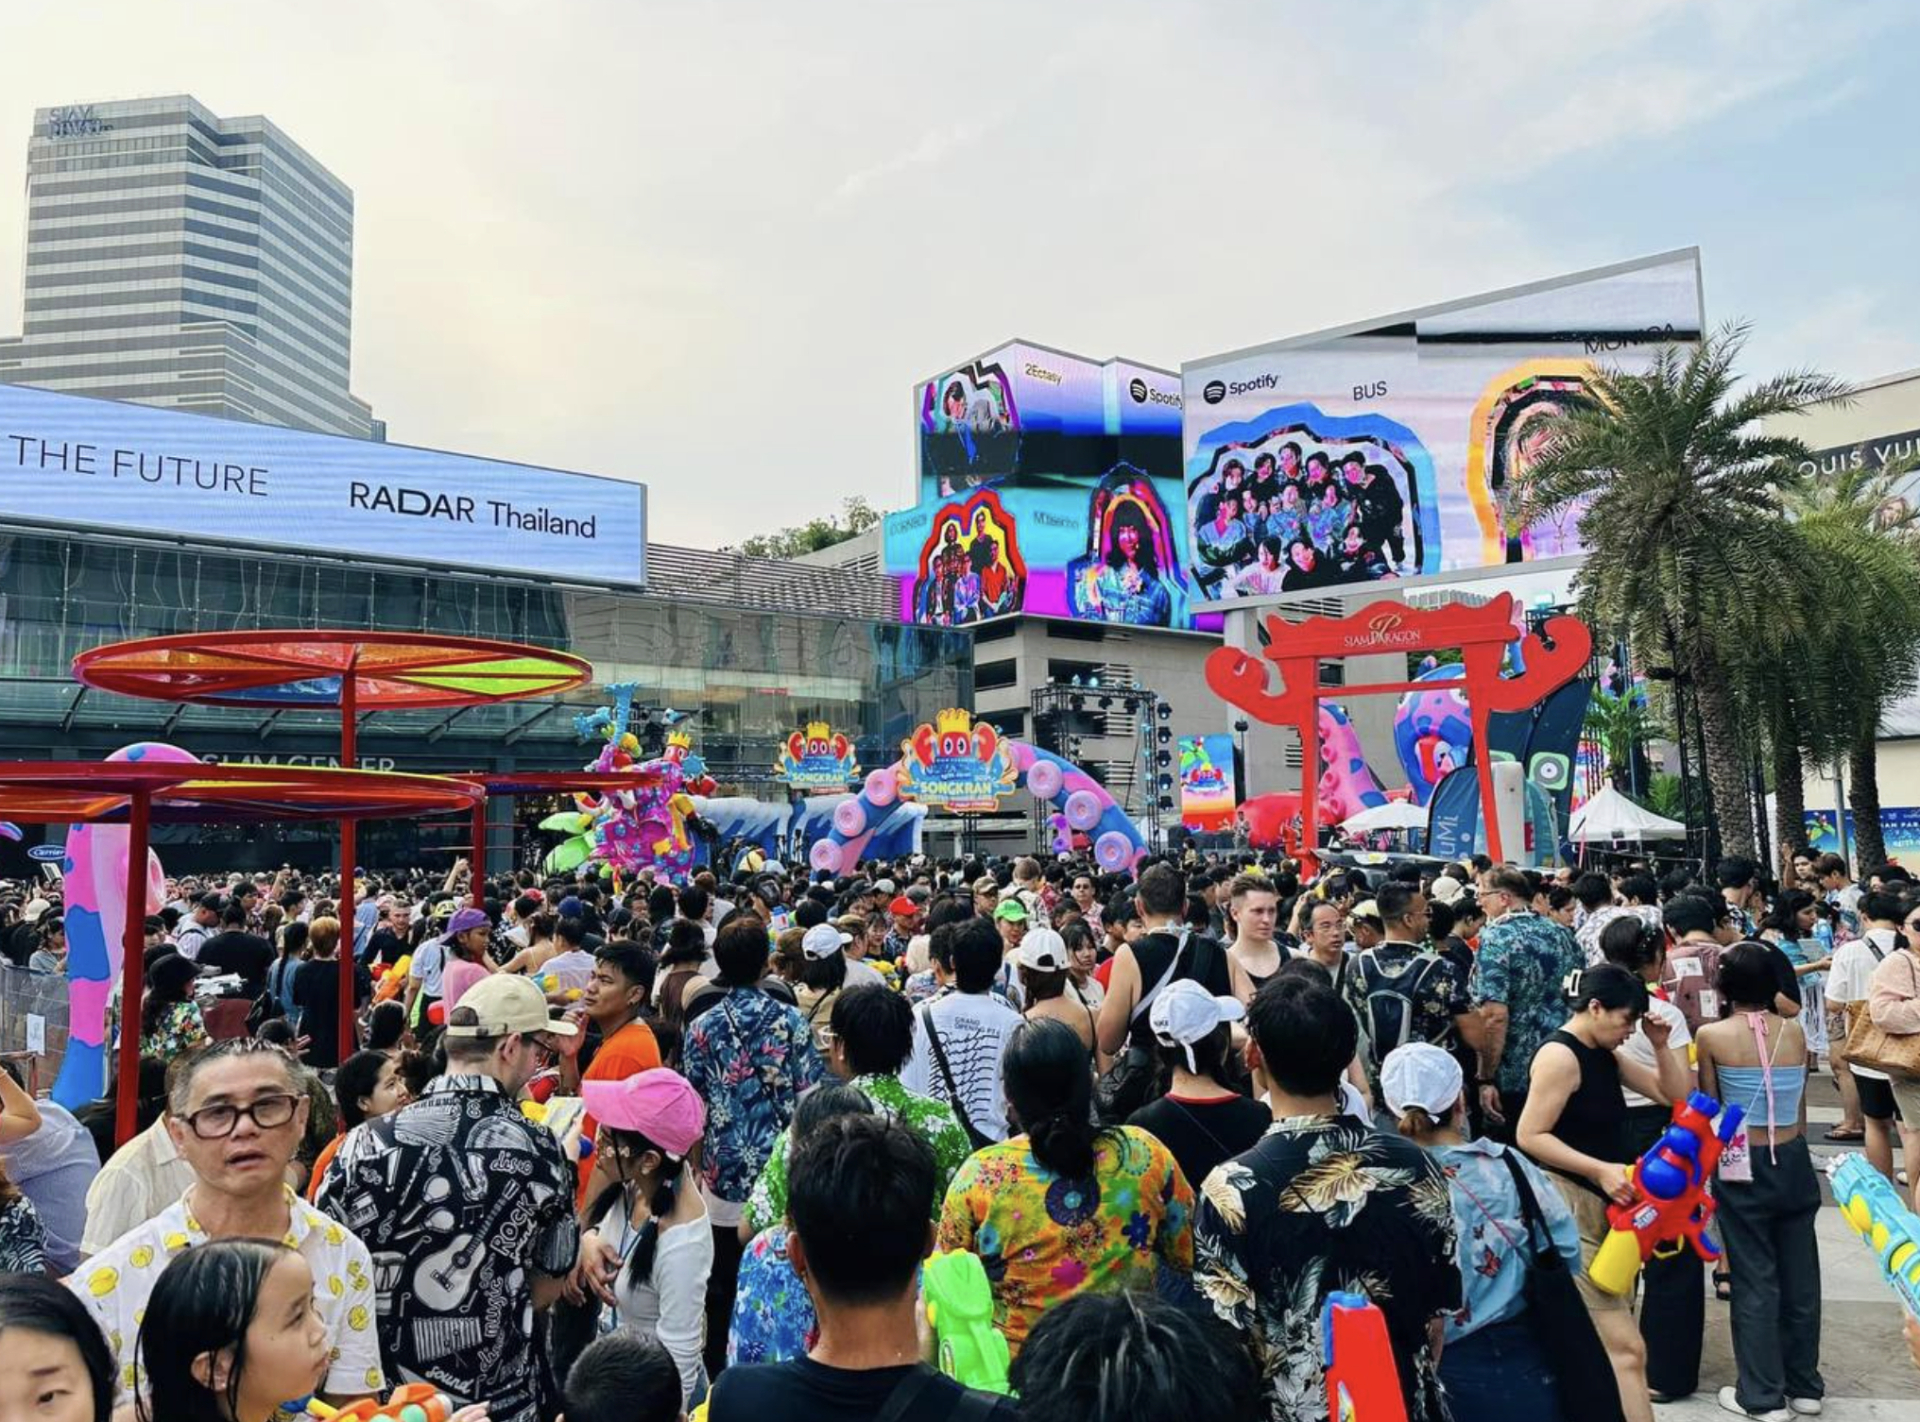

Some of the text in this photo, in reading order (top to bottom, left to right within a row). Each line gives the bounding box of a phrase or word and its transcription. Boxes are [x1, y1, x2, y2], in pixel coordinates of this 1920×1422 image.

[1228, 373, 1279, 396] Spotify
[1352, 380, 1388, 401] BUS
[8, 435, 269, 496] THE FUTURE
[1797, 438, 1920, 479] OUIS VUI
[350, 481, 596, 539] RADAR Thailand
[1344, 634, 1371, 647] SIAM
[288, 755, 395, 772] CENER
[921, 781, 991, 796] SONGKRAN
[489, 1150, 534, 1175] disco
[489, 1193, 540, 1257] ROCK
[483, 1276, 509, 1338] music
[425, 1366, 474, 1394] sound
